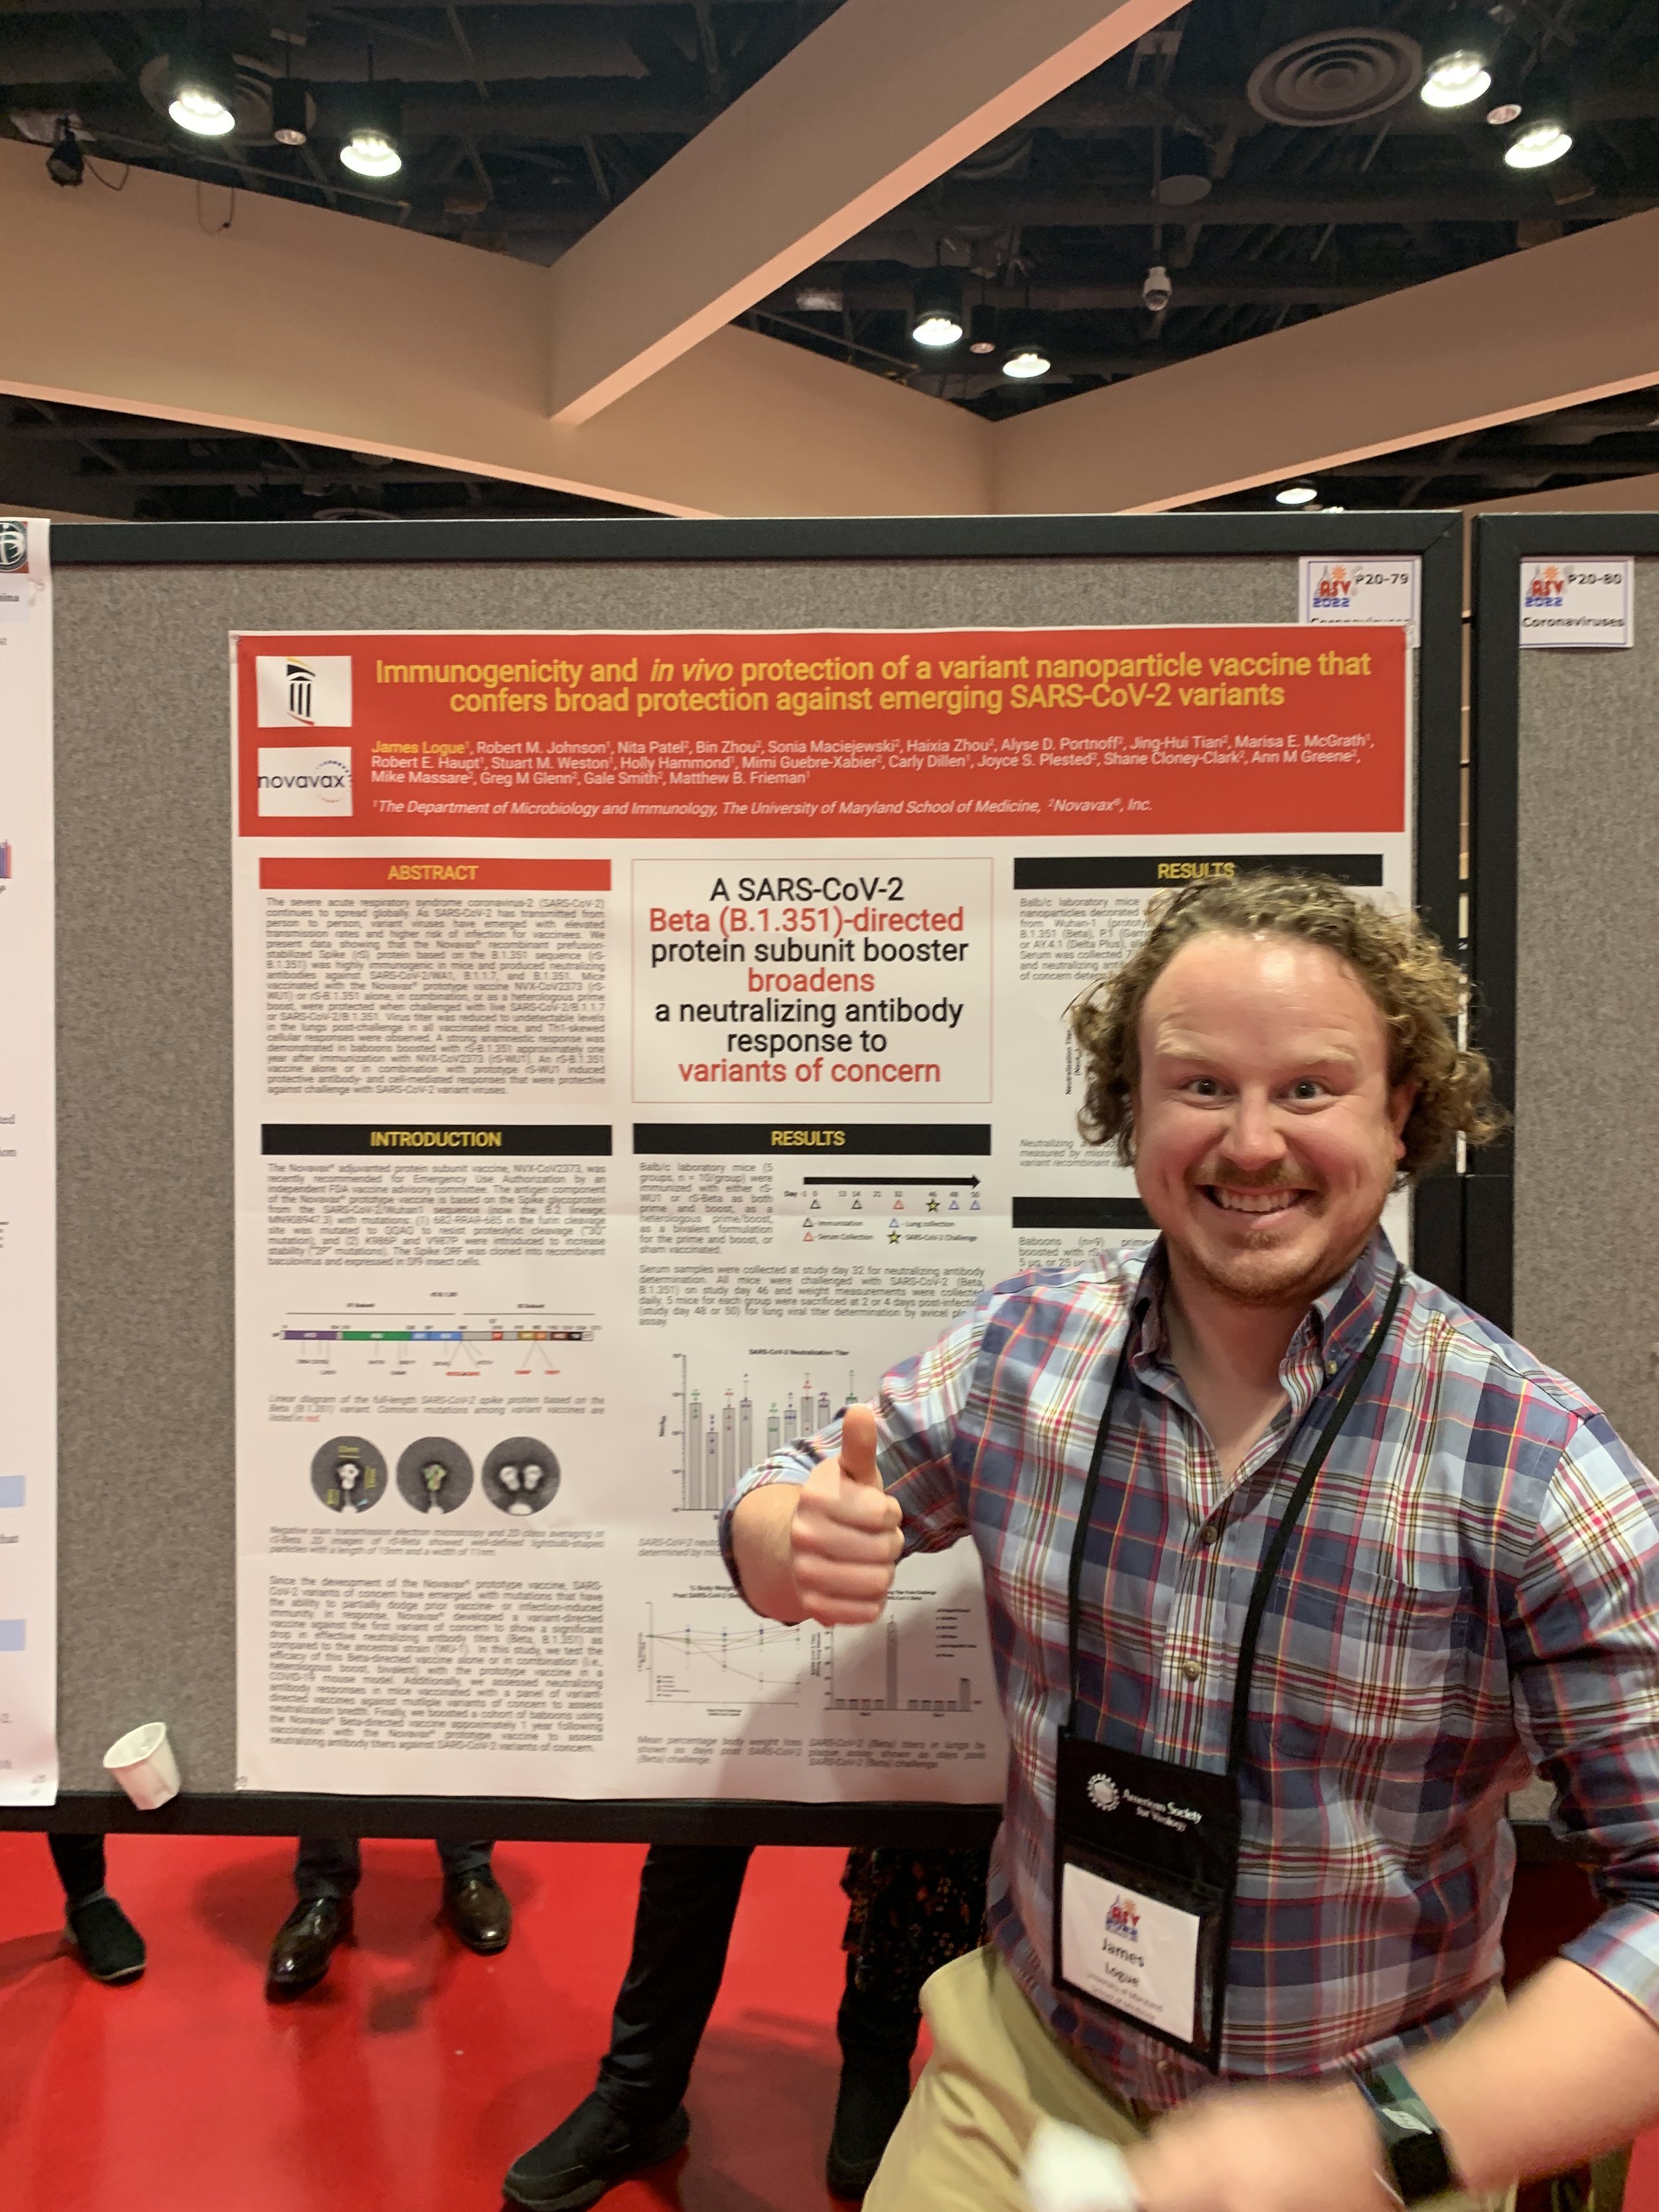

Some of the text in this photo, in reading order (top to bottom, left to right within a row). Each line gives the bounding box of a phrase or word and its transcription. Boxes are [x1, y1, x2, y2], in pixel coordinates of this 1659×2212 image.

[1355, 573, 1409, 585] P20-79
[1567, 573, 1622, 585] P20-80
[1313, 597, 1350, 609] 2022
[1524, 597, 1563, 607] 2022
[1522, 616, 1626, 628] Coronaviruses
[376, 652, 1371, 688] Immunogenicity and in vivo protection of a variant nanoparticle vaccine that
[450, 682, 1285, 716] confers broad protection against emerging SARS-CoV-2 variants
[372, 741, 420, 754] James
[476, 741, 523, 754] Robert
[525, 741, 543, 754] M.
[617, 741, 646, 753] Nita
[695, 741, 719, 753] Bin
[768, 740, 808, 753] Sonia
[906, 739, 950, 752] Haixia
[1001, 738, 1039, 755] Alyse
[1042, 738, 1056, 751] D.
[1130, 737, 1189, 753] Jing-Hui
[1234, 735, 1284, 749] Marisa
[1287, 735, 1299, 748] E.
[371, 756, 419, 769] Robert
[421, 756, 434, 769] E.
[490, 756, 533, 769] Stuart
[536, 756, 554, 769] M.
[620, 756, 656, 772] Holly
[741, 755, 777, 769] Mimi
[888, 755, 924, 771] Carly
[977, 754, 1019, 771] Joyce
[1021, 754, 1035, 767] S.
[1104, 753, 1148, 766] Shane
[1251, 751, 1280, 764] Ann
[1282, 751, 1298, 763] M
[257, 775, 346, 788] novavax
[370, 771, 405, 783] Mike
[479, 771, 514, 788] Greg
[515, 772, 530, 784] M
[583, 772, 615, 784] Gale
[669, 772, 730, 784] Matthew
[732, 772, 746, 784] B.
[406, 800, 492, 817] Department
[492, 801, 510, 814] of
[510, 801, 601, 818] Microbiology
[602, 802, 631, 814] and
[631, 802, 719, 818] Immunology,
[723, 802, 750, 814] The
[751, 801, 820, 818] University
[820, 801, 838, 814] of
[838, 801, 905, 817] Maryland
[906, 800, 956, 814] School
[956, 800, 974, 813] of
[974, 799, 1042, 815] Medicine,
[1127, 798, 1152, 811] Inc.
[388, 865, 476, 881] ABSTRACT
[710, 878, 904, 901] A SARS-CoV-2
[1019, 897, 1141, 909] Balb/c laboratory mice
[649, 905, 964, 938] Beta (B.1.351)-directed
[1019, 908, 1139, 919] nanoparticles decorated
[651, 938, 968, 968] protein subunit booster
[1019, 950, 1052, 960] Serum
[1077, 949, 1123, 959] collected
[747, 968, 875, 992] broadens
[655, 997, 963, 1028] a neutralizing antibody
[727, 1029, 887, 1059] response to
[679, 1058, 941, 1082] variants of concern
[370, 1132, 502, 1147] INTRODUCTION
[771, 1130, 845, 1146] RESULTS
[1019, 1236, 1062, 1246] Baboons
[638, 1264, 671, 1274] Serum
[673, 1264, 715, 1276] samples
[743, 1265, 787, 1274] collected
[789, 1265, 800, 1274] at
[802, 1265, 829, 1277] study
[831, 1265, 849, 1278] day
[852, 1266, 865, 1275] 32
[867, 1266, 881, 1275] for
[883, 1266, 941, 1278] neutralizing
[942, 1266, 985, 1279] antibody
[1102, 1937, 1145, 1968] James
